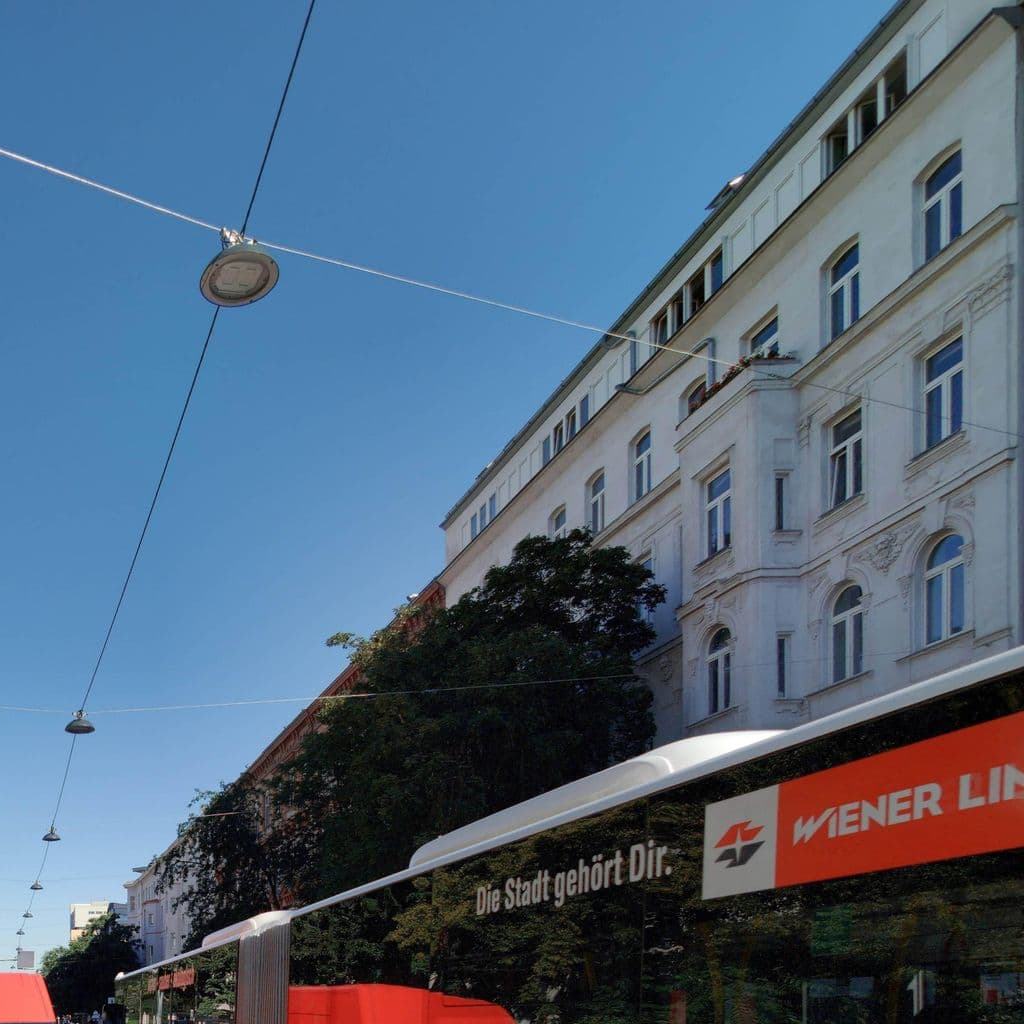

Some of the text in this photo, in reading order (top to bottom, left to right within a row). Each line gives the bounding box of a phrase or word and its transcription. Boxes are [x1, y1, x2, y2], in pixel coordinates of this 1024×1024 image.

[792, 782, 944, 847] WIENER
[476, 838, 673, 916] Die Stadt gehört Dir.
